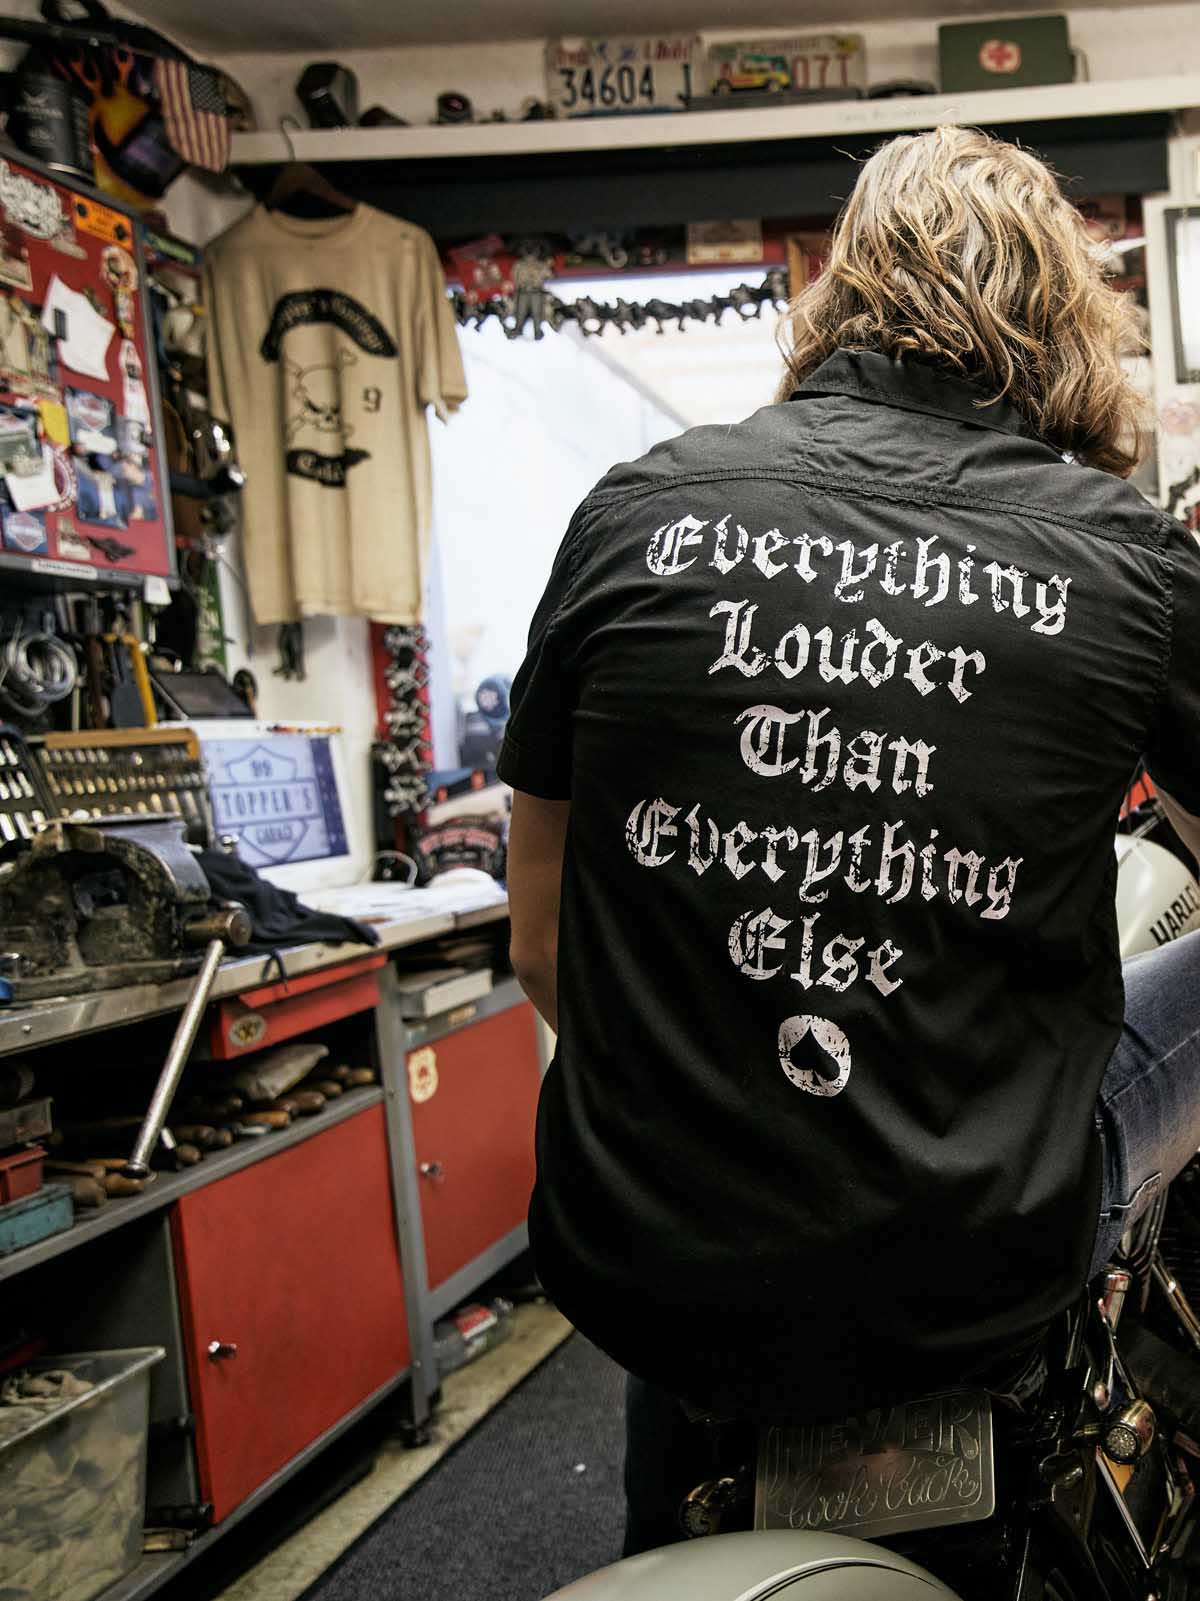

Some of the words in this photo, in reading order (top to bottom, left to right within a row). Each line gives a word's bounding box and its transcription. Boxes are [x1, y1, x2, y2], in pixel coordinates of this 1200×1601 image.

[559, 64, 656, 107] 34604
[362, 386, 382, 413] 9
[645, 513, 1073, 636] Everything
[708, 598, 987, 704] Louder
[733, 703, 938, 798] Than
[218, 787, 315, 819] TOPPER'S
[625, 796, 1024, 921] Everything
[727, 905, 905, 997] Else
